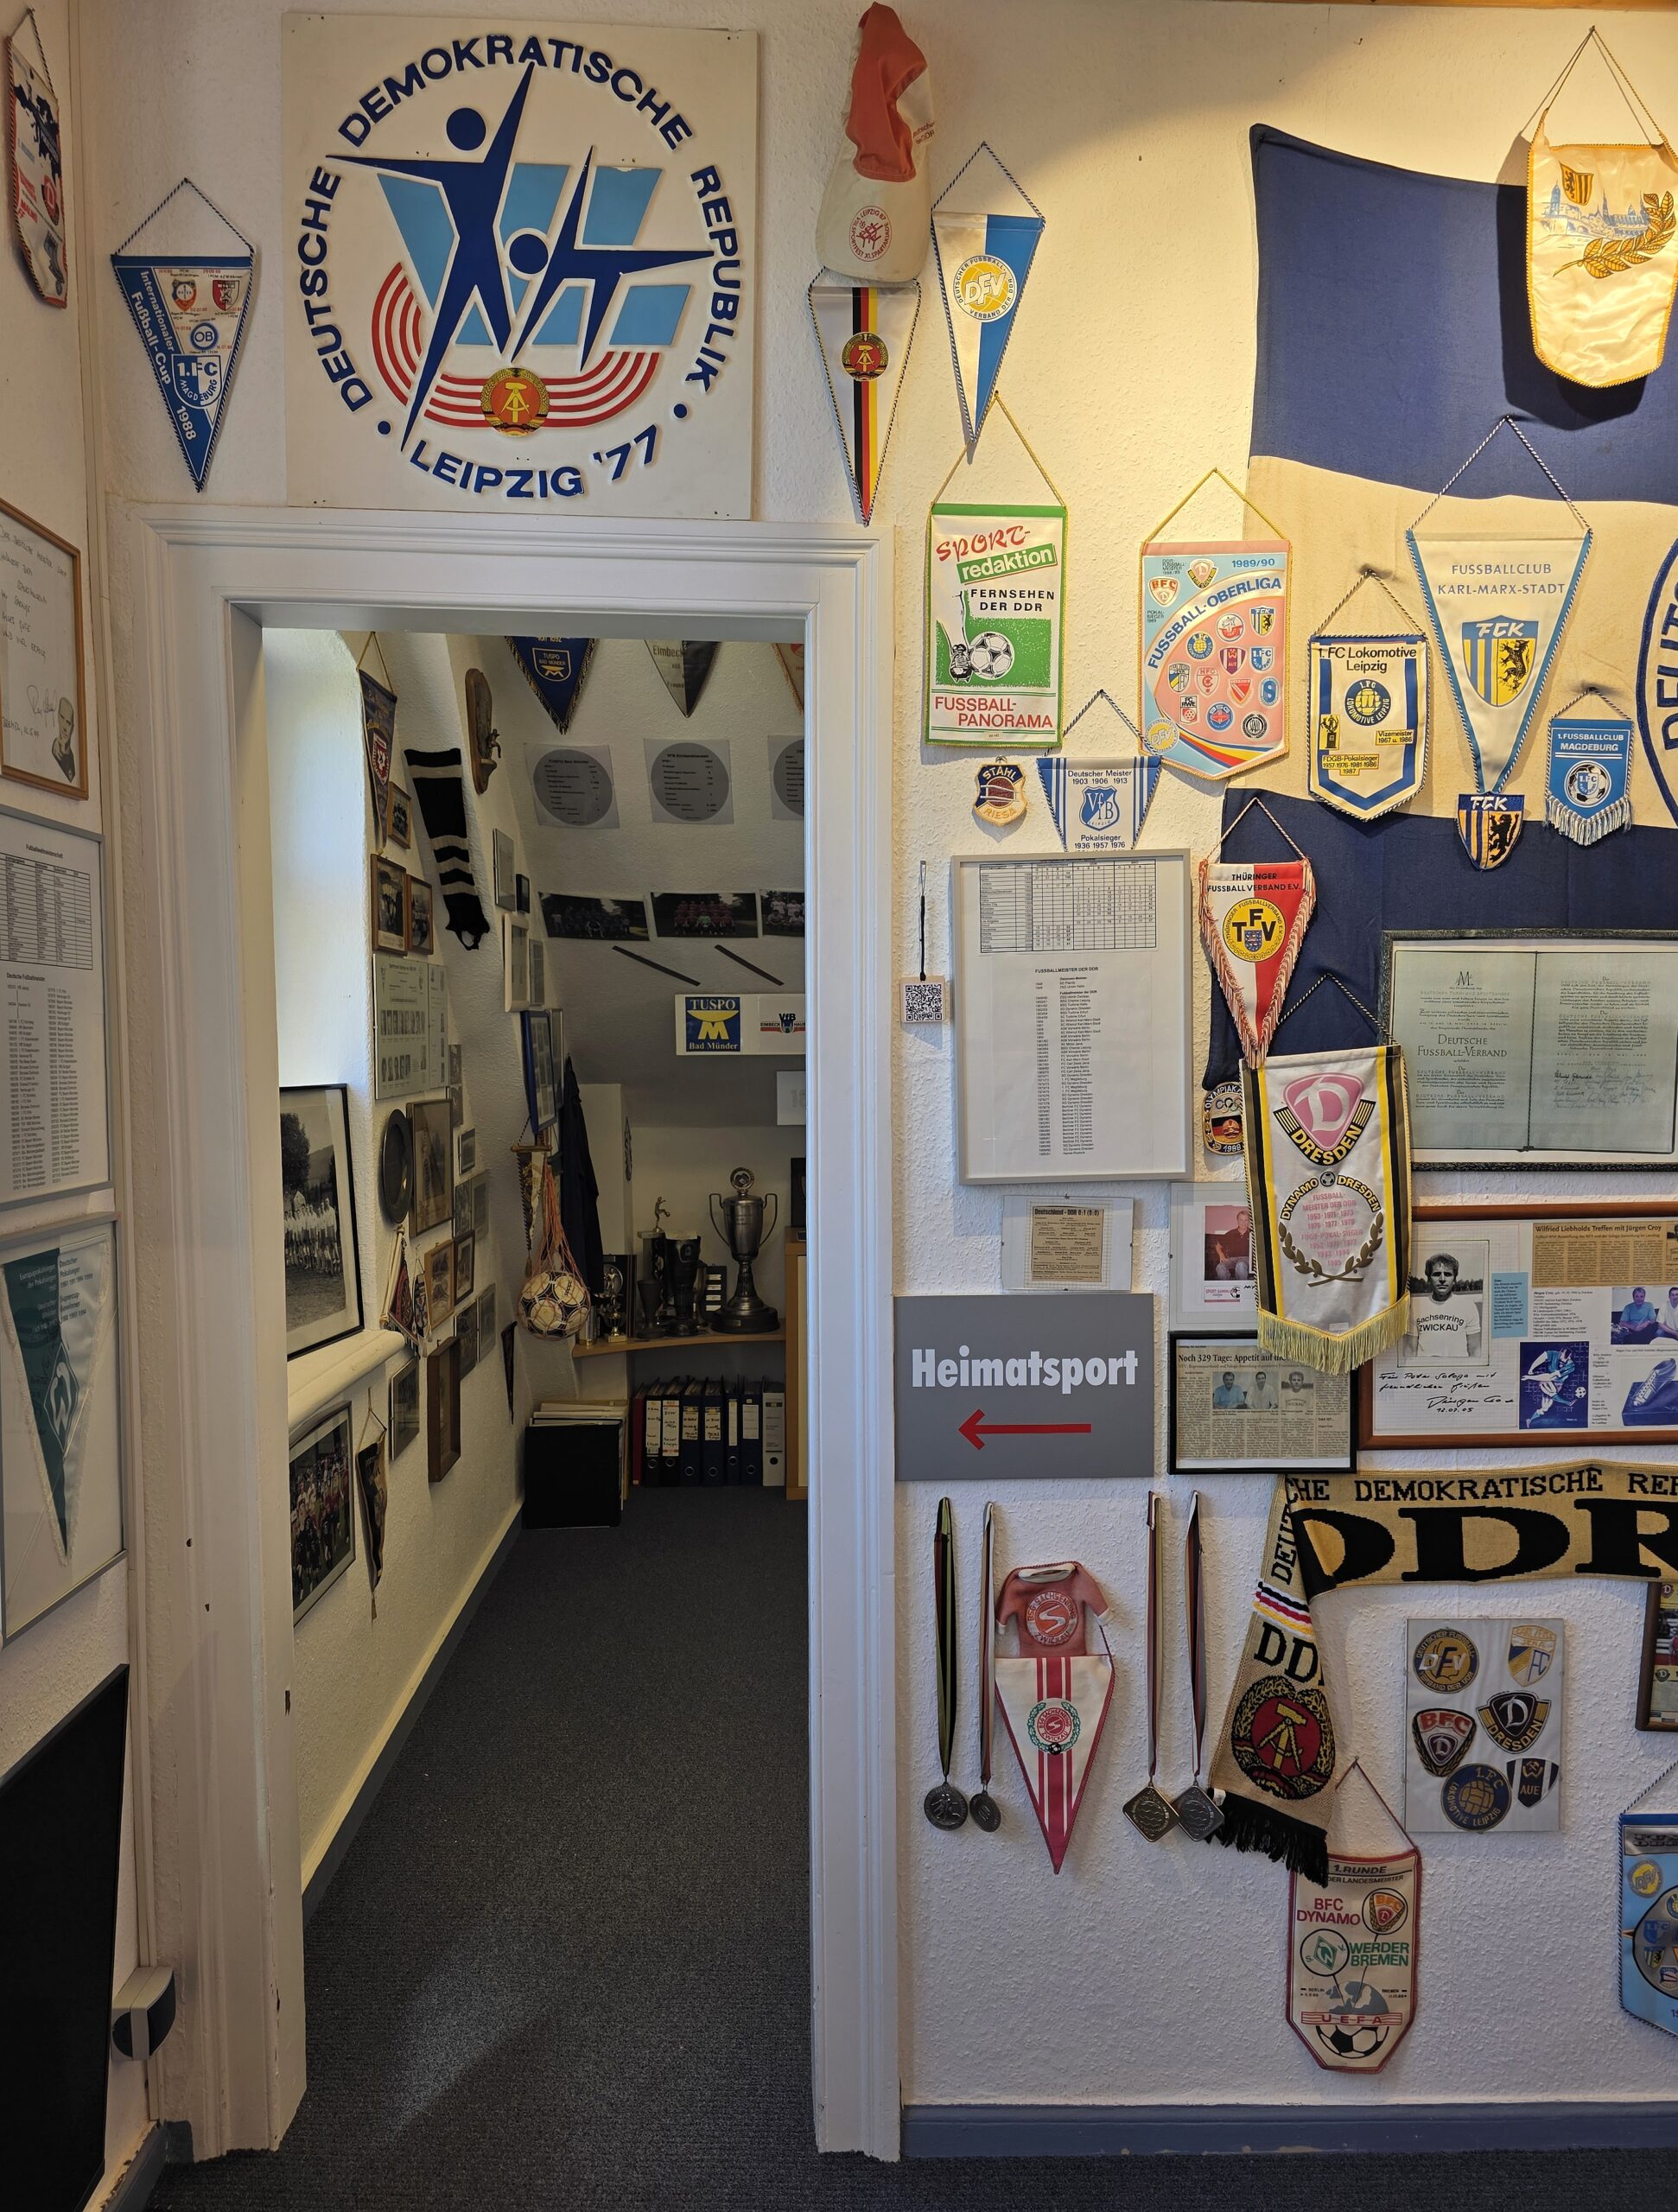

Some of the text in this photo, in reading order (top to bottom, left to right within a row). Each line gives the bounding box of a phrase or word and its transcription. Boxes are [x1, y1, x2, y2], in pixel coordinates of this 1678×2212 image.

[860, 208, 880, 218] LEIPZIG
[297, 35, 742, 412] DEUTSCHE DEMOKRATISCHE REPUBLIK
[955, 263, 969, 304] DEUTSCHER
[964, 272, 1006, 305] DFV
[140, 270, 175, 352] Internationaler
[969, 308, 1001, 319] VERBAND
[1001, 297, 1012, 310] DER
[130, 291, 171, 385] Fußball-Cup
[194, 331, 213, 342] OB
[176, 362, 218, 378] 1.FC
[180, 378, 218, 402] MAGDEBURG
[175, 405, 196, 441] 1988
[409, 424, 658, 499] LEIPZIG '77
[961, 546, 1053, 581] redaktion
[1231, 558, 1275, 569] 1989/90
[1452, 563, 1552, 575] FUSSBALLCLUB
[1152, 580, 1177, 589] BFC
[1438, 583, 1566, 595] KARL-MARX-STADT
[970, 588, 1055, 600] FERNSEHEN
[980, 602, 1043, 612] DER DDR
[1475, 622, 1525, 638] FCK
[1328, 647, 1345, 658] FC
[1348, 646, 1417, 658] Lokomotive
[1346, 660, 1388, 674] Leipzig
[935, 696, 1017, 712] FUSSBALL-
[1346, 697, 1389, 724] LOKOMOTIVE LEIPZIG
[958, 714, 1053, 728] PANORAMA
[1150, 727, 1174, 746] DFV
[982, 766, 1017, 780] STAHL
[1087, 793, 1114, 820] VfB
[1470, 796, 1508, 810] FCK
[983, 808, 1016, 820] RIESA
[1231, 872, 1277, 880] THÜRINGER
[1224, 899, 1282, 939] THÜRINGER FUSSBALLVERBAND
[690, 999, 735, 1009] TUSPO
[1438, 1034, 1488, 1045] DEUTSCHE
[1418, 1046, 1508, 1058] FUSSBALL-VERBAND
[1291, 1125, 1363, 1165] DRESDEN
[1281, 1175, 1381, 1220] DYNAMO DRESDEN
[1313, 1192, 1346, 1201] FUSSBALL-
[1303, 1202, 1328, 1211] MEISTER
[1626, 1224, 1646, 1233] Jürgen
[1416, 1313, 1465, 1326] Sachsenring
[1213, 1355, 1233, 1363] Tage:
[1234, 1355, 1260, 1363] Appetit
[912, 1344, 1138, 1394] Heimatsport
[1355, 1469, 1605, 1502] DEMOKRATISCHE
[1027, 1592, 1076, 1622] BSG SACHSENRING
[1035, 1630, 1071, 1645] ZWICKAU
[1416, 1631, 1447, 1659] DEUTSCHER
[1254, 1621, 1325, 1687] DD
[1419, 1647, 1467, 1678] DFV
[1528, 1649, 1550, 1681] FC
[1042, 1707, 1071, 1728] SACHSENRING
[1419, 1713, 1472, 1735] BFC
[1041, 1731, 1068, 1742] ZWICKAU
[1490, 1722, 1542, 1751] DRESDEN
[1520, 1785, 1541, 1795] AUE
[1446, 1783, 1501, 1826] LOKOMOTIVE LEIPZIG
[1342, 1875, 1404, 1884] LANDESMEISTER
[1313, 1897, 1344, 1910] BFC
[1297, 1910, 1361, 1925] DYNAMO
[1349, 1942, 1409, 1954] WERDER
[1351, 1955, 1409, 1967] BREMEN
[1321, 2014, 1384, 2024] UEFA
